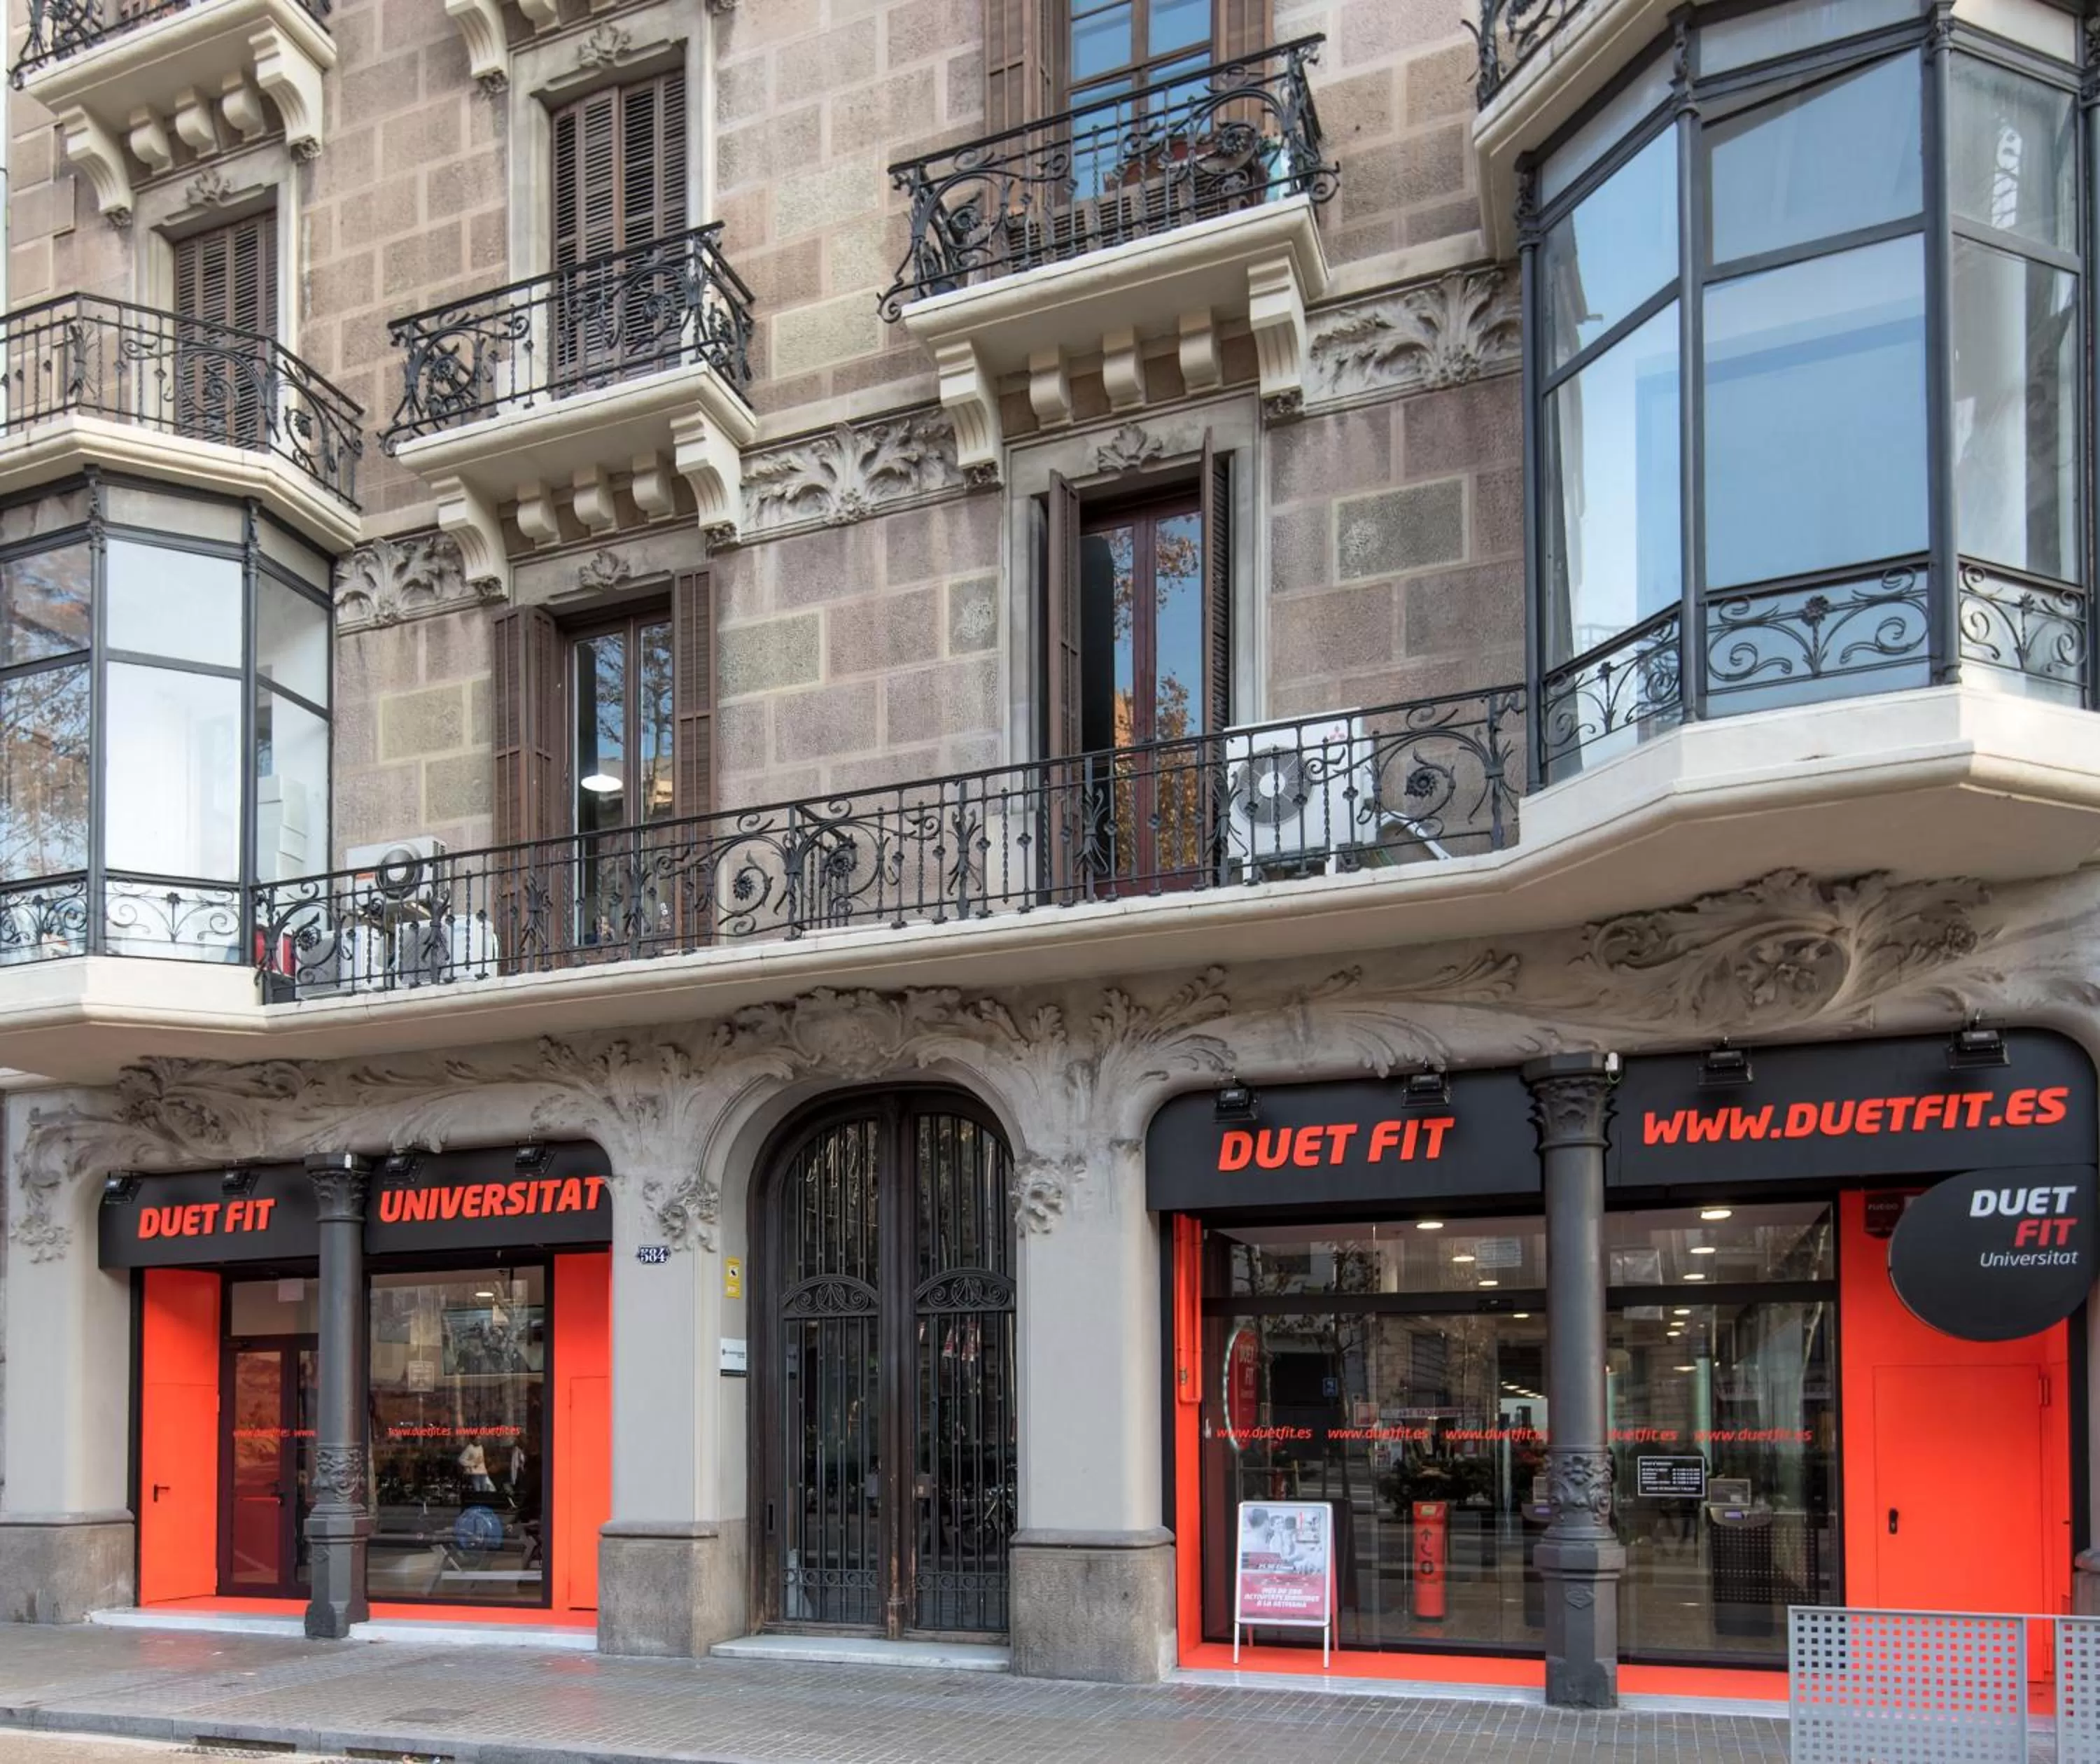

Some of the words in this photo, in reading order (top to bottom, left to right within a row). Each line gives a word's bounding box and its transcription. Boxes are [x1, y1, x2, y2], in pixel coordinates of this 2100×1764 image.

[1644, 1086, 2068, 1145] WWW.DUETFIT.ES
[1218, 1123, 1358, 1172] DUET
[1367, 1117, 1455, 1163] FIT
[379, 1175, 605, 1223] UNIVERSITAT
[1969, 1186, 2077, 1217] DUET
[138, 1203, 220, 1239] DUET
[225, 1198, 276, 1231] FIT
[2014, 1217, 2078, 1247] FIT
[1980, 1250, 2078, 1267] Universitat
[1216, 1426, 1312, 1440] www.duetfit.es
[1327, 1426, 1429, 1441] www.duetfit.es
[1693, 1428, 1813, 1442] www.duetfit.es
